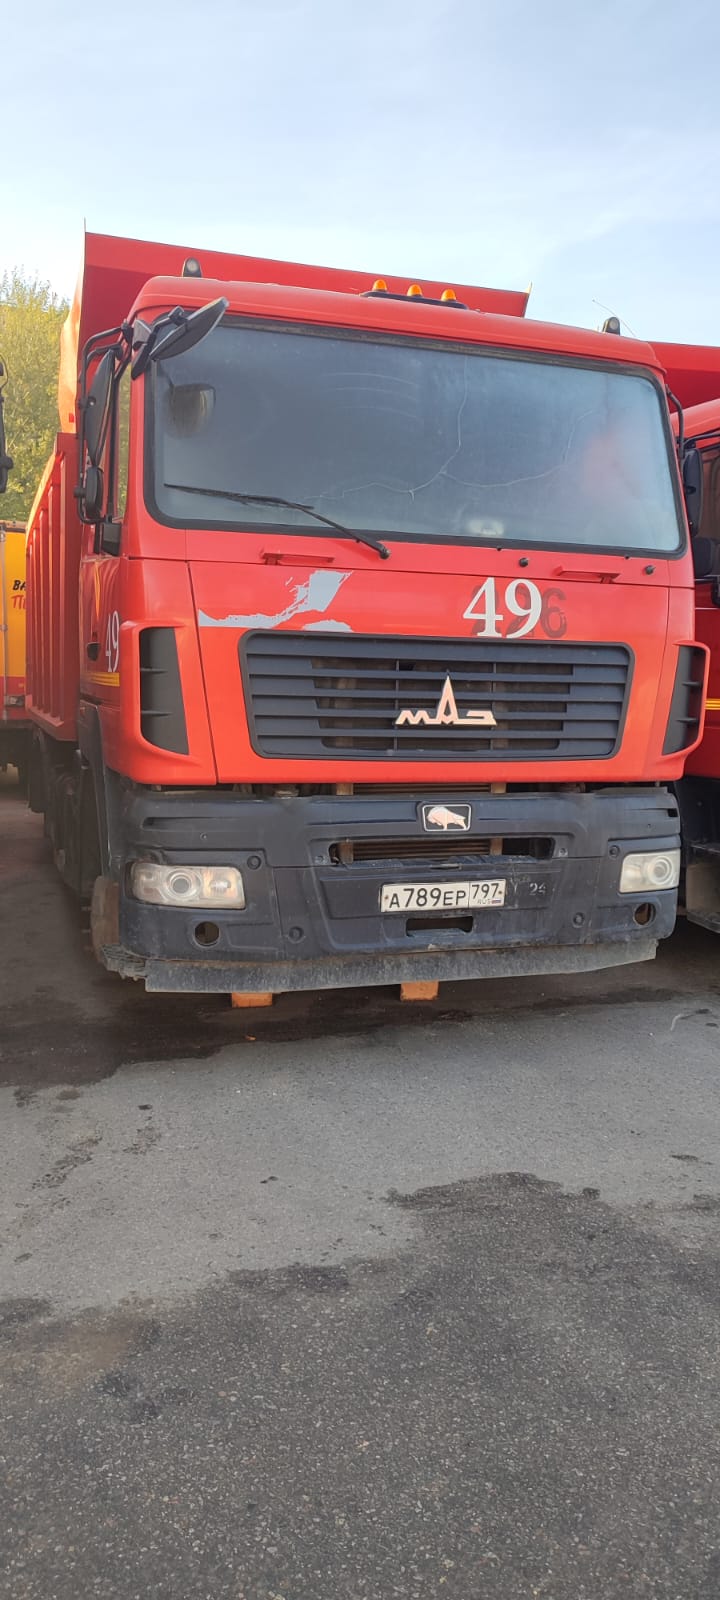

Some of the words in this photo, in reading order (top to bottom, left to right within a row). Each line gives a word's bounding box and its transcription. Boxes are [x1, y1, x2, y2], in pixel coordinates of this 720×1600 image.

[462, 576, 542, 639] 49
[105, 610, 119, 673] 49
[395, 674, 497, 725] МАЗ
[388, 888, 466, 909] А789ЕР
[471, 883, 500, 899] 797
